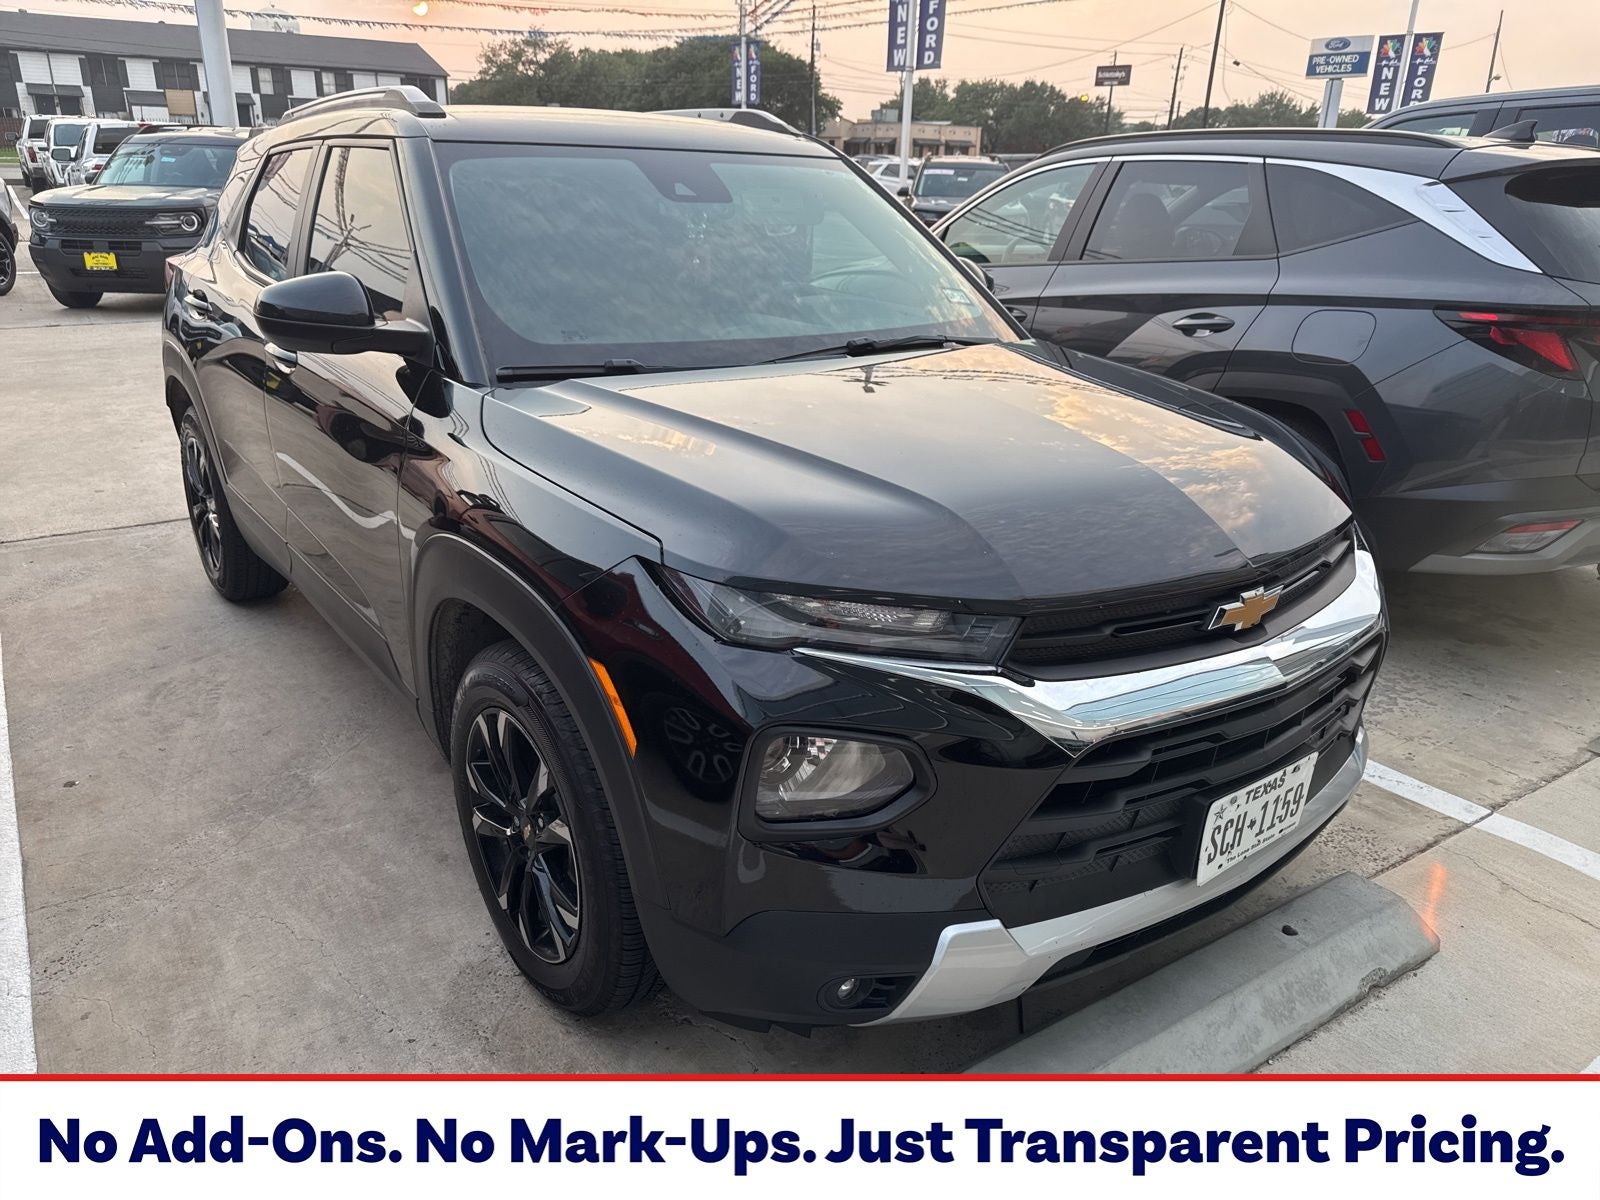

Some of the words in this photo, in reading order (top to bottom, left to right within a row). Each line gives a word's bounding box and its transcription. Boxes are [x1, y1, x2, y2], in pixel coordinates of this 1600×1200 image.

[893, 4, 908, 67] NEW
[923, 0, 939, 65] FORD
[1312, 54, 1360, 65] PRE-OWNED
[1315, 63, 1353, 74] VEHICLES
[749, 65, 757, 101] FORD
[1374, 67, 1394, 111] NEW
[1245, 774, 1287, 805] TEXAS
